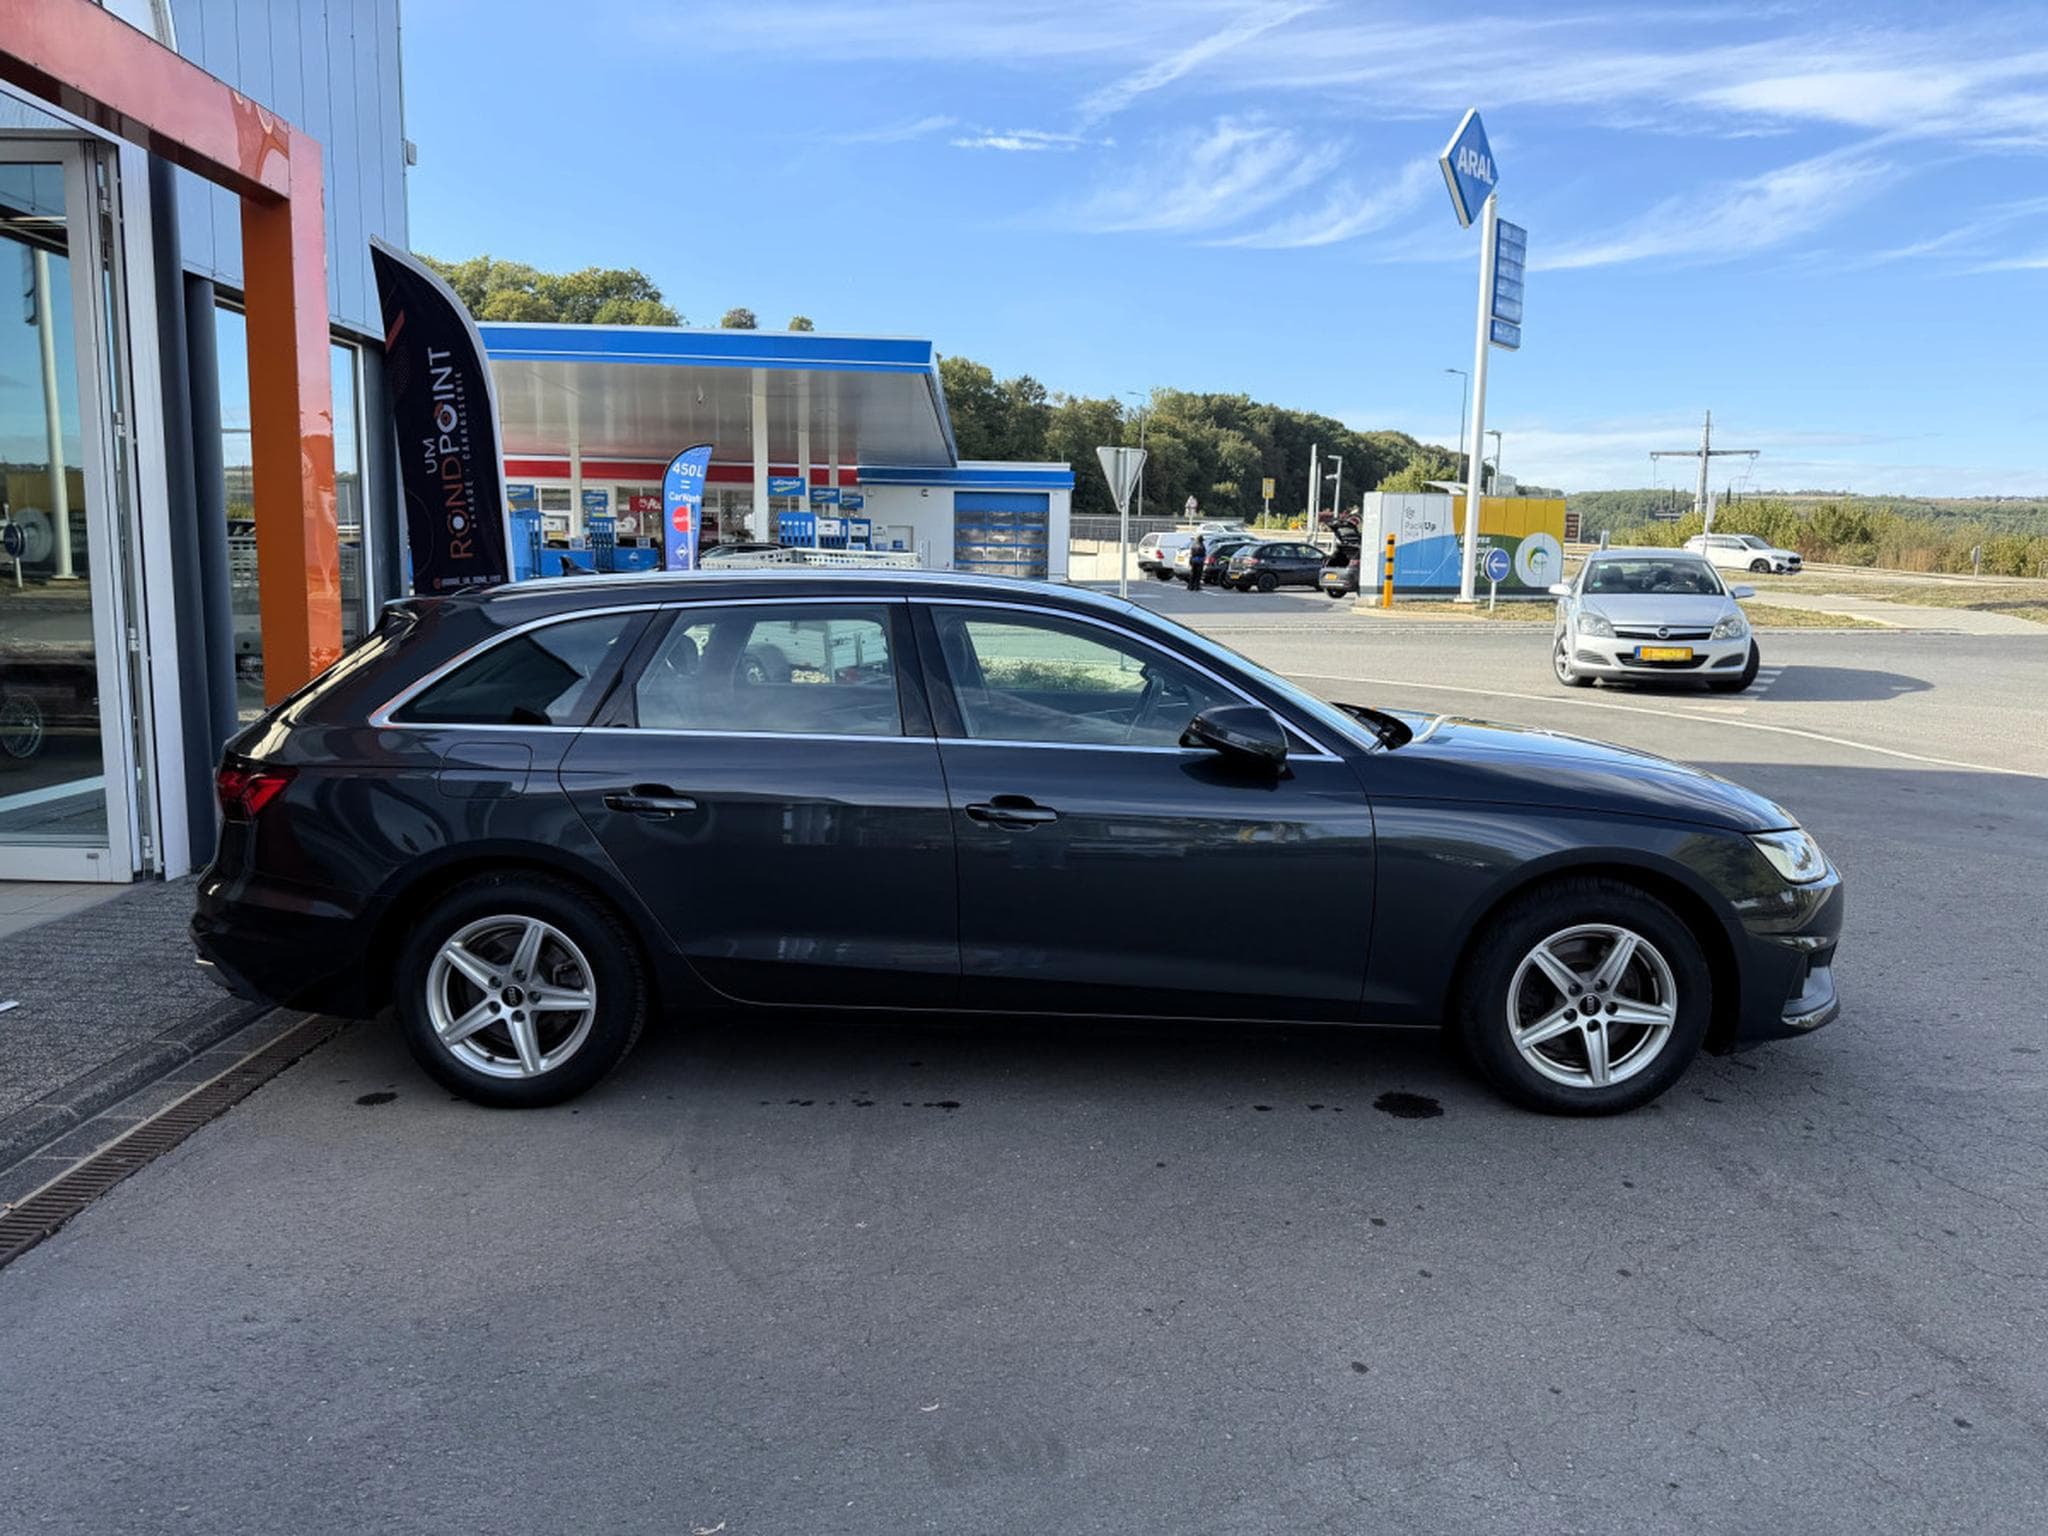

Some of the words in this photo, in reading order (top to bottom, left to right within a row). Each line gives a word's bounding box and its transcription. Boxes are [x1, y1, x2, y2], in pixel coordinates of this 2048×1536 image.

[1456, 146, 1494, 185] ARAL
[423, 438, 438, 474] UM
[427, 346, 473, 560] RONDPOINT
[672, 462, 704, 478] 450L
